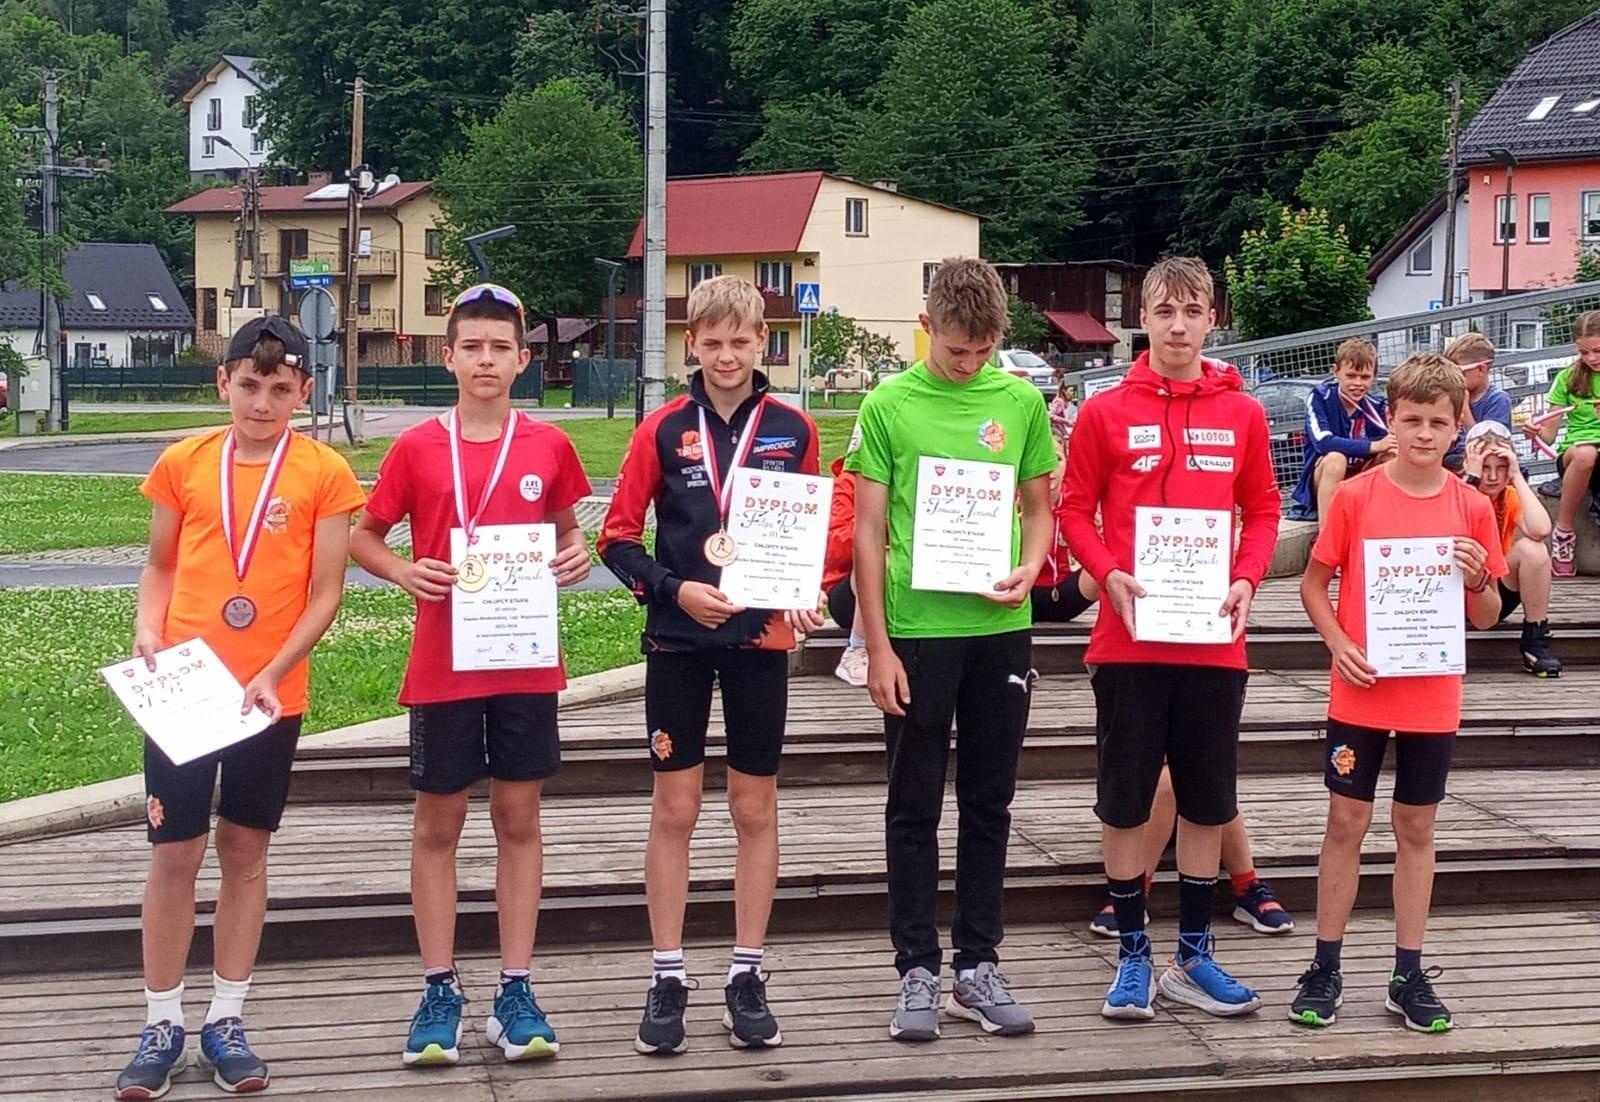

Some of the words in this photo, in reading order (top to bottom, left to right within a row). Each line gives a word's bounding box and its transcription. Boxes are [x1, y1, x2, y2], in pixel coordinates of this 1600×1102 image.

[1201, 432, 1230, 442] LOTOS
[753, 440, 798, 453] IMPRODEX
[1131, 454, 1162, 472] 4F
[1199, 459, 1231, 467] RENAULT
[931, 484, 1001, 501] DYPLOM
[745, 496, 818, 515] DYPLOM
[1148, 534, 1218, 549] DYPLOM
[1378, 564, 1451, 577] DYPLOM
